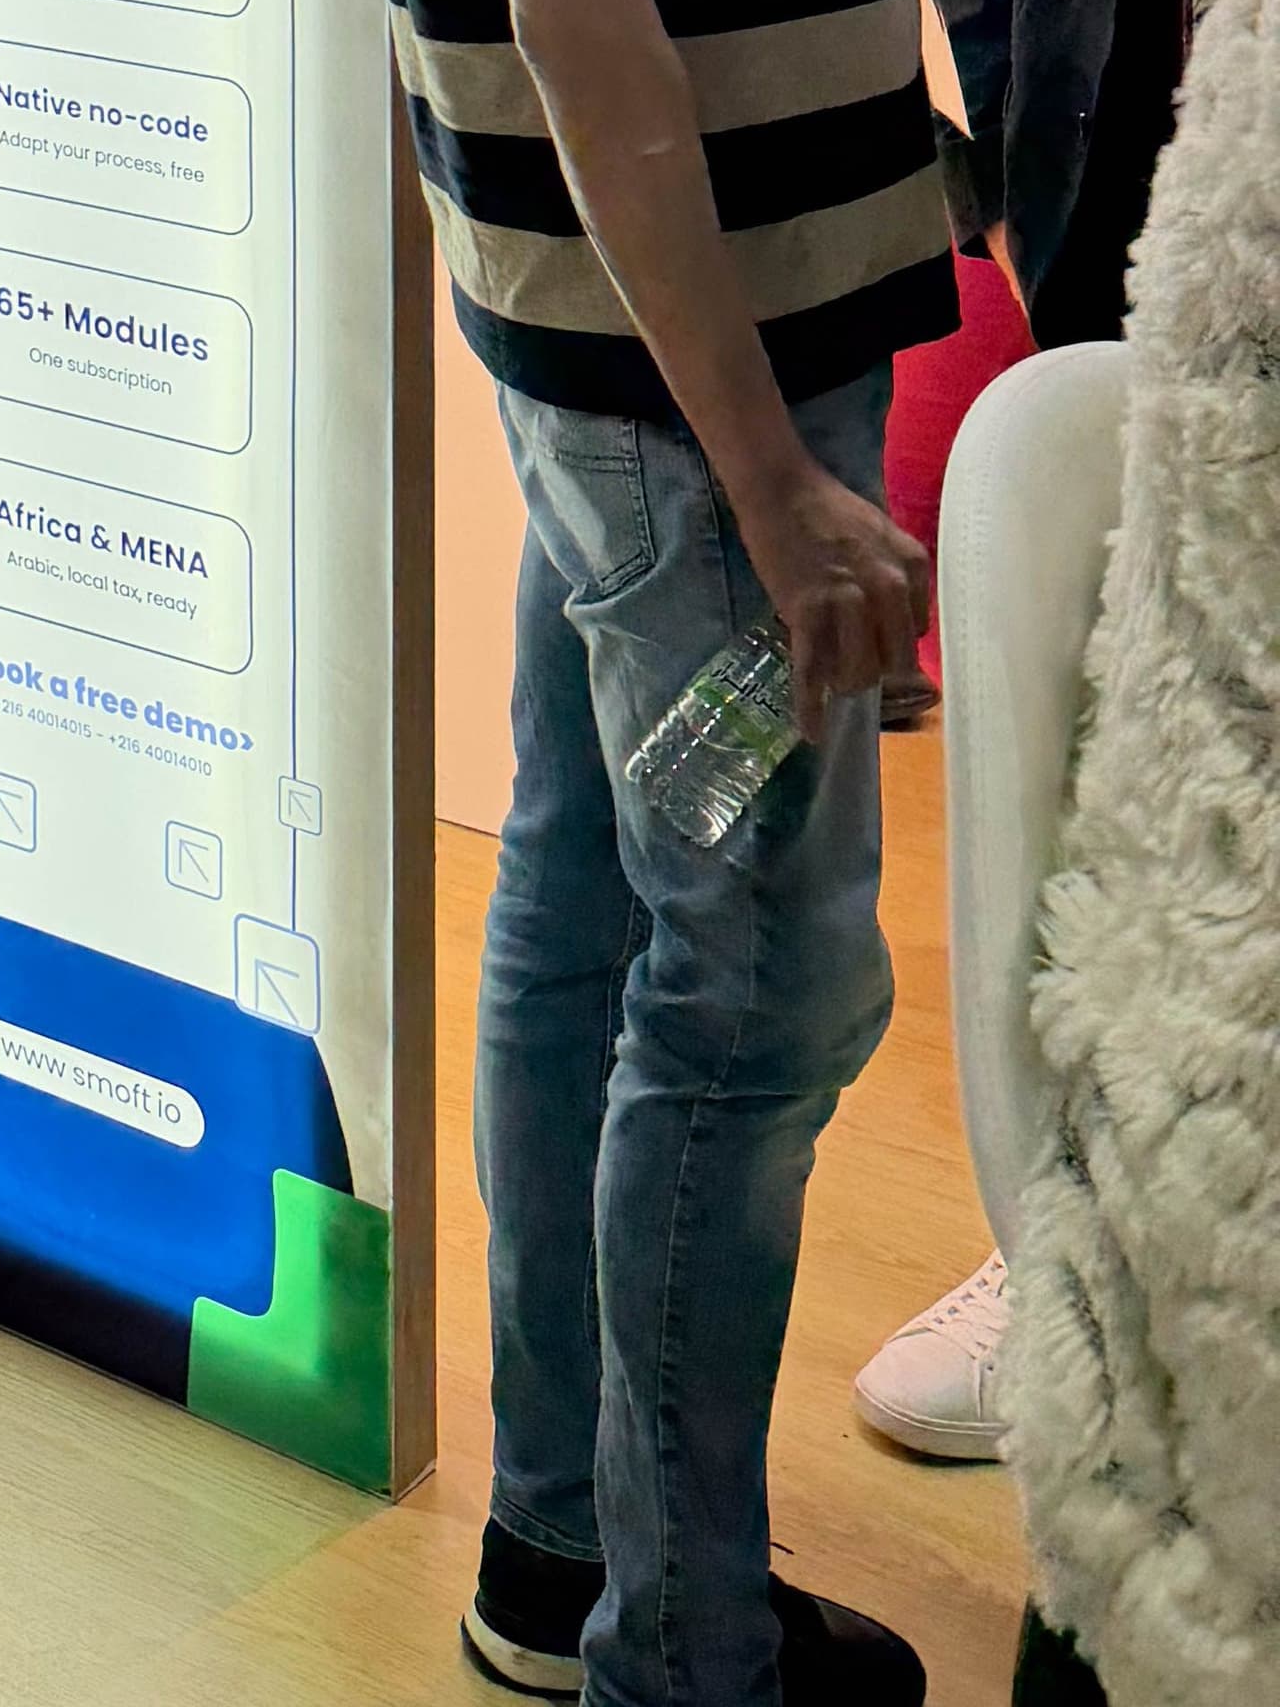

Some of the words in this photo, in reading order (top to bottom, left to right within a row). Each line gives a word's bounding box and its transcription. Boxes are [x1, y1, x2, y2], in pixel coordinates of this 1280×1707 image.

[90, 103, 209, 142] no-code
[53, 140, 90, 159] your
[95, 148, 166, 179] process,
[170, 160, 205, 183] free
[64, 303, 209, 361] Modules
[29, 347, 63, 368] One
[67, 358, 172, 395] subscription
[91, 524, 112, 552] &
[121, 531, 209, 579] MENA
[6, 550, 64, 582] Arabic,
[67, 565, 109, 592] local
[113, 578, 142, 603] tax,
[146, 589, 198, 620] ready
[50, 675, 69, 699] a
[74, 676, 138, 720] free
[27, 708, 92, 739] 40014015
[109, 734, 141, 754] +216
[145, 745, 213, 776] 40014010
